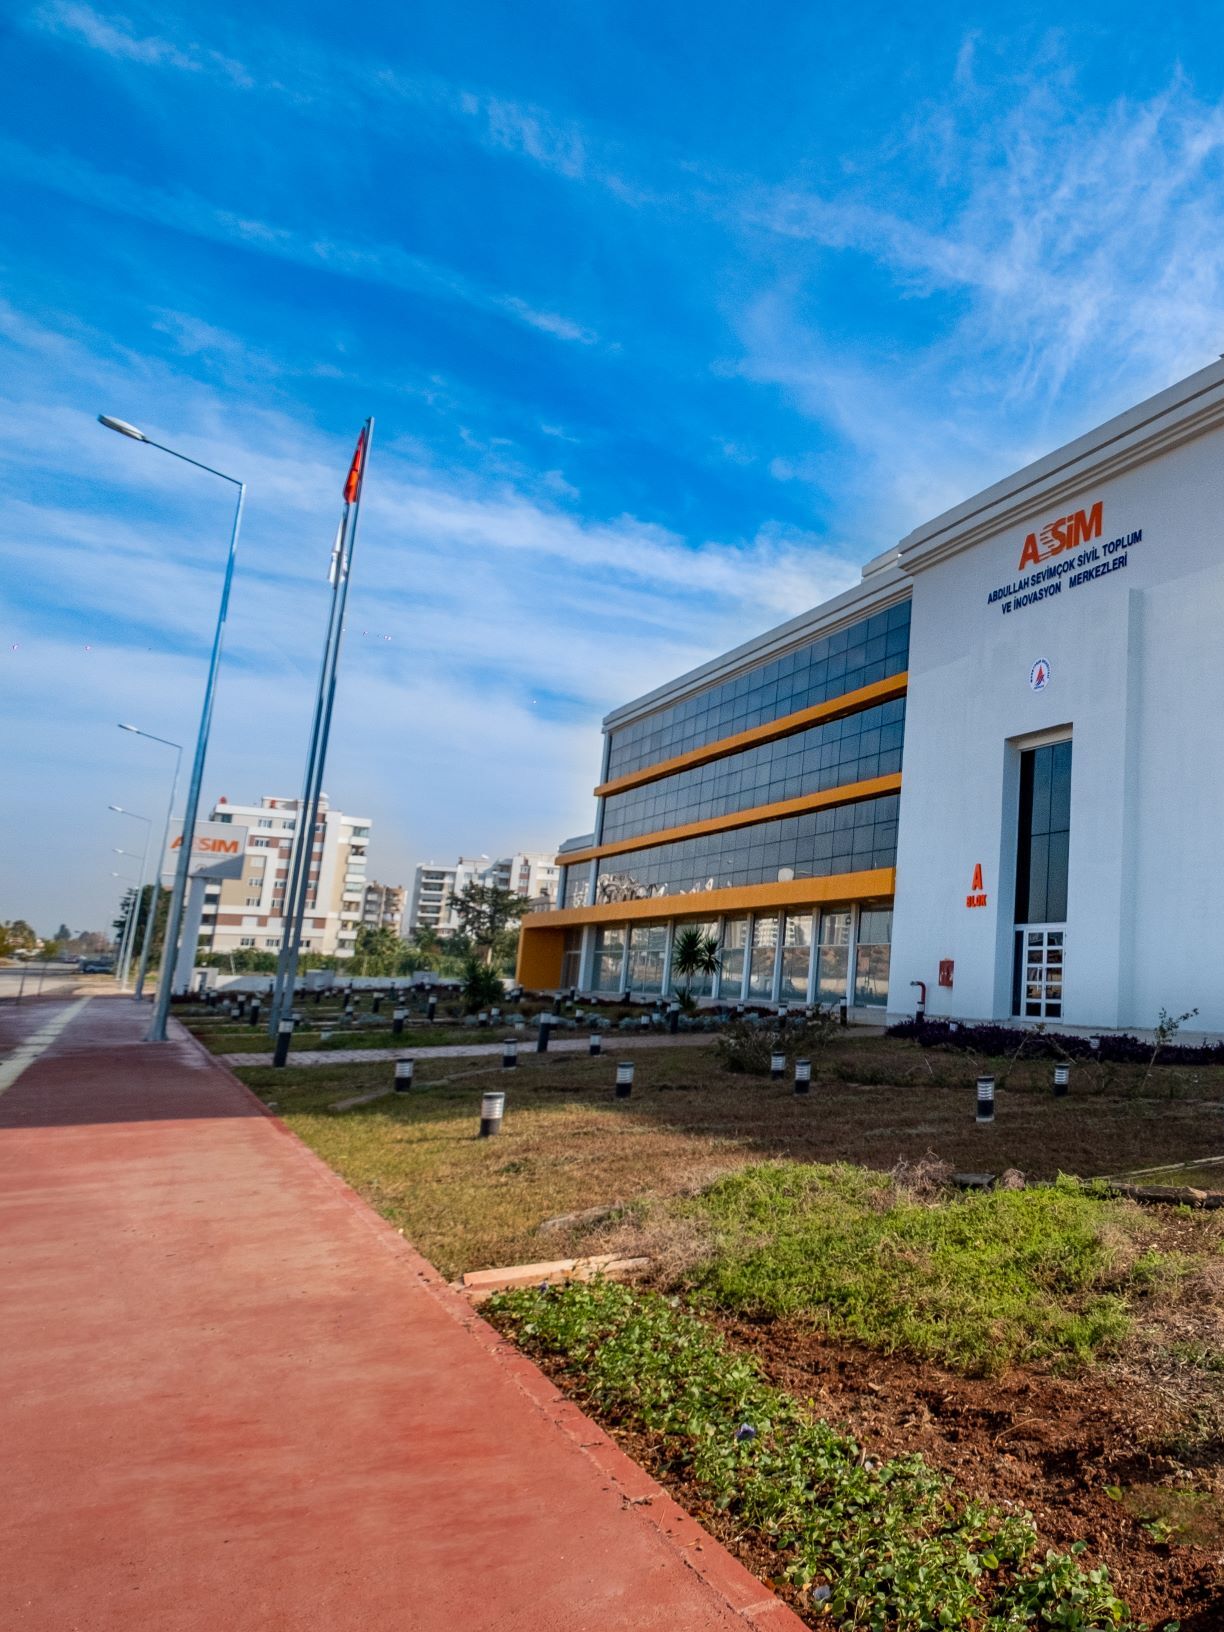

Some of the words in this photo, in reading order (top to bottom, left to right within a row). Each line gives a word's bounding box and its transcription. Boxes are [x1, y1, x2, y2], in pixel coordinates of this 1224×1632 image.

[987, 576, 1030, 605] ABDULLAH
[1030, 557, 1076, 586] SEVİMÇOK
[1077, 546, 1100, 568] SİVİL
[1102, 529, 1143, 557] TOPLUM
[1001, 601, 1012, 615] VE
[1013, 581, 1062, 611] İNOVASYON
[1069, 551, 1128, 589] MERKEZLERİ
[972, 863, 983, 890] A
[966, 894, 987, 908] BLOK
